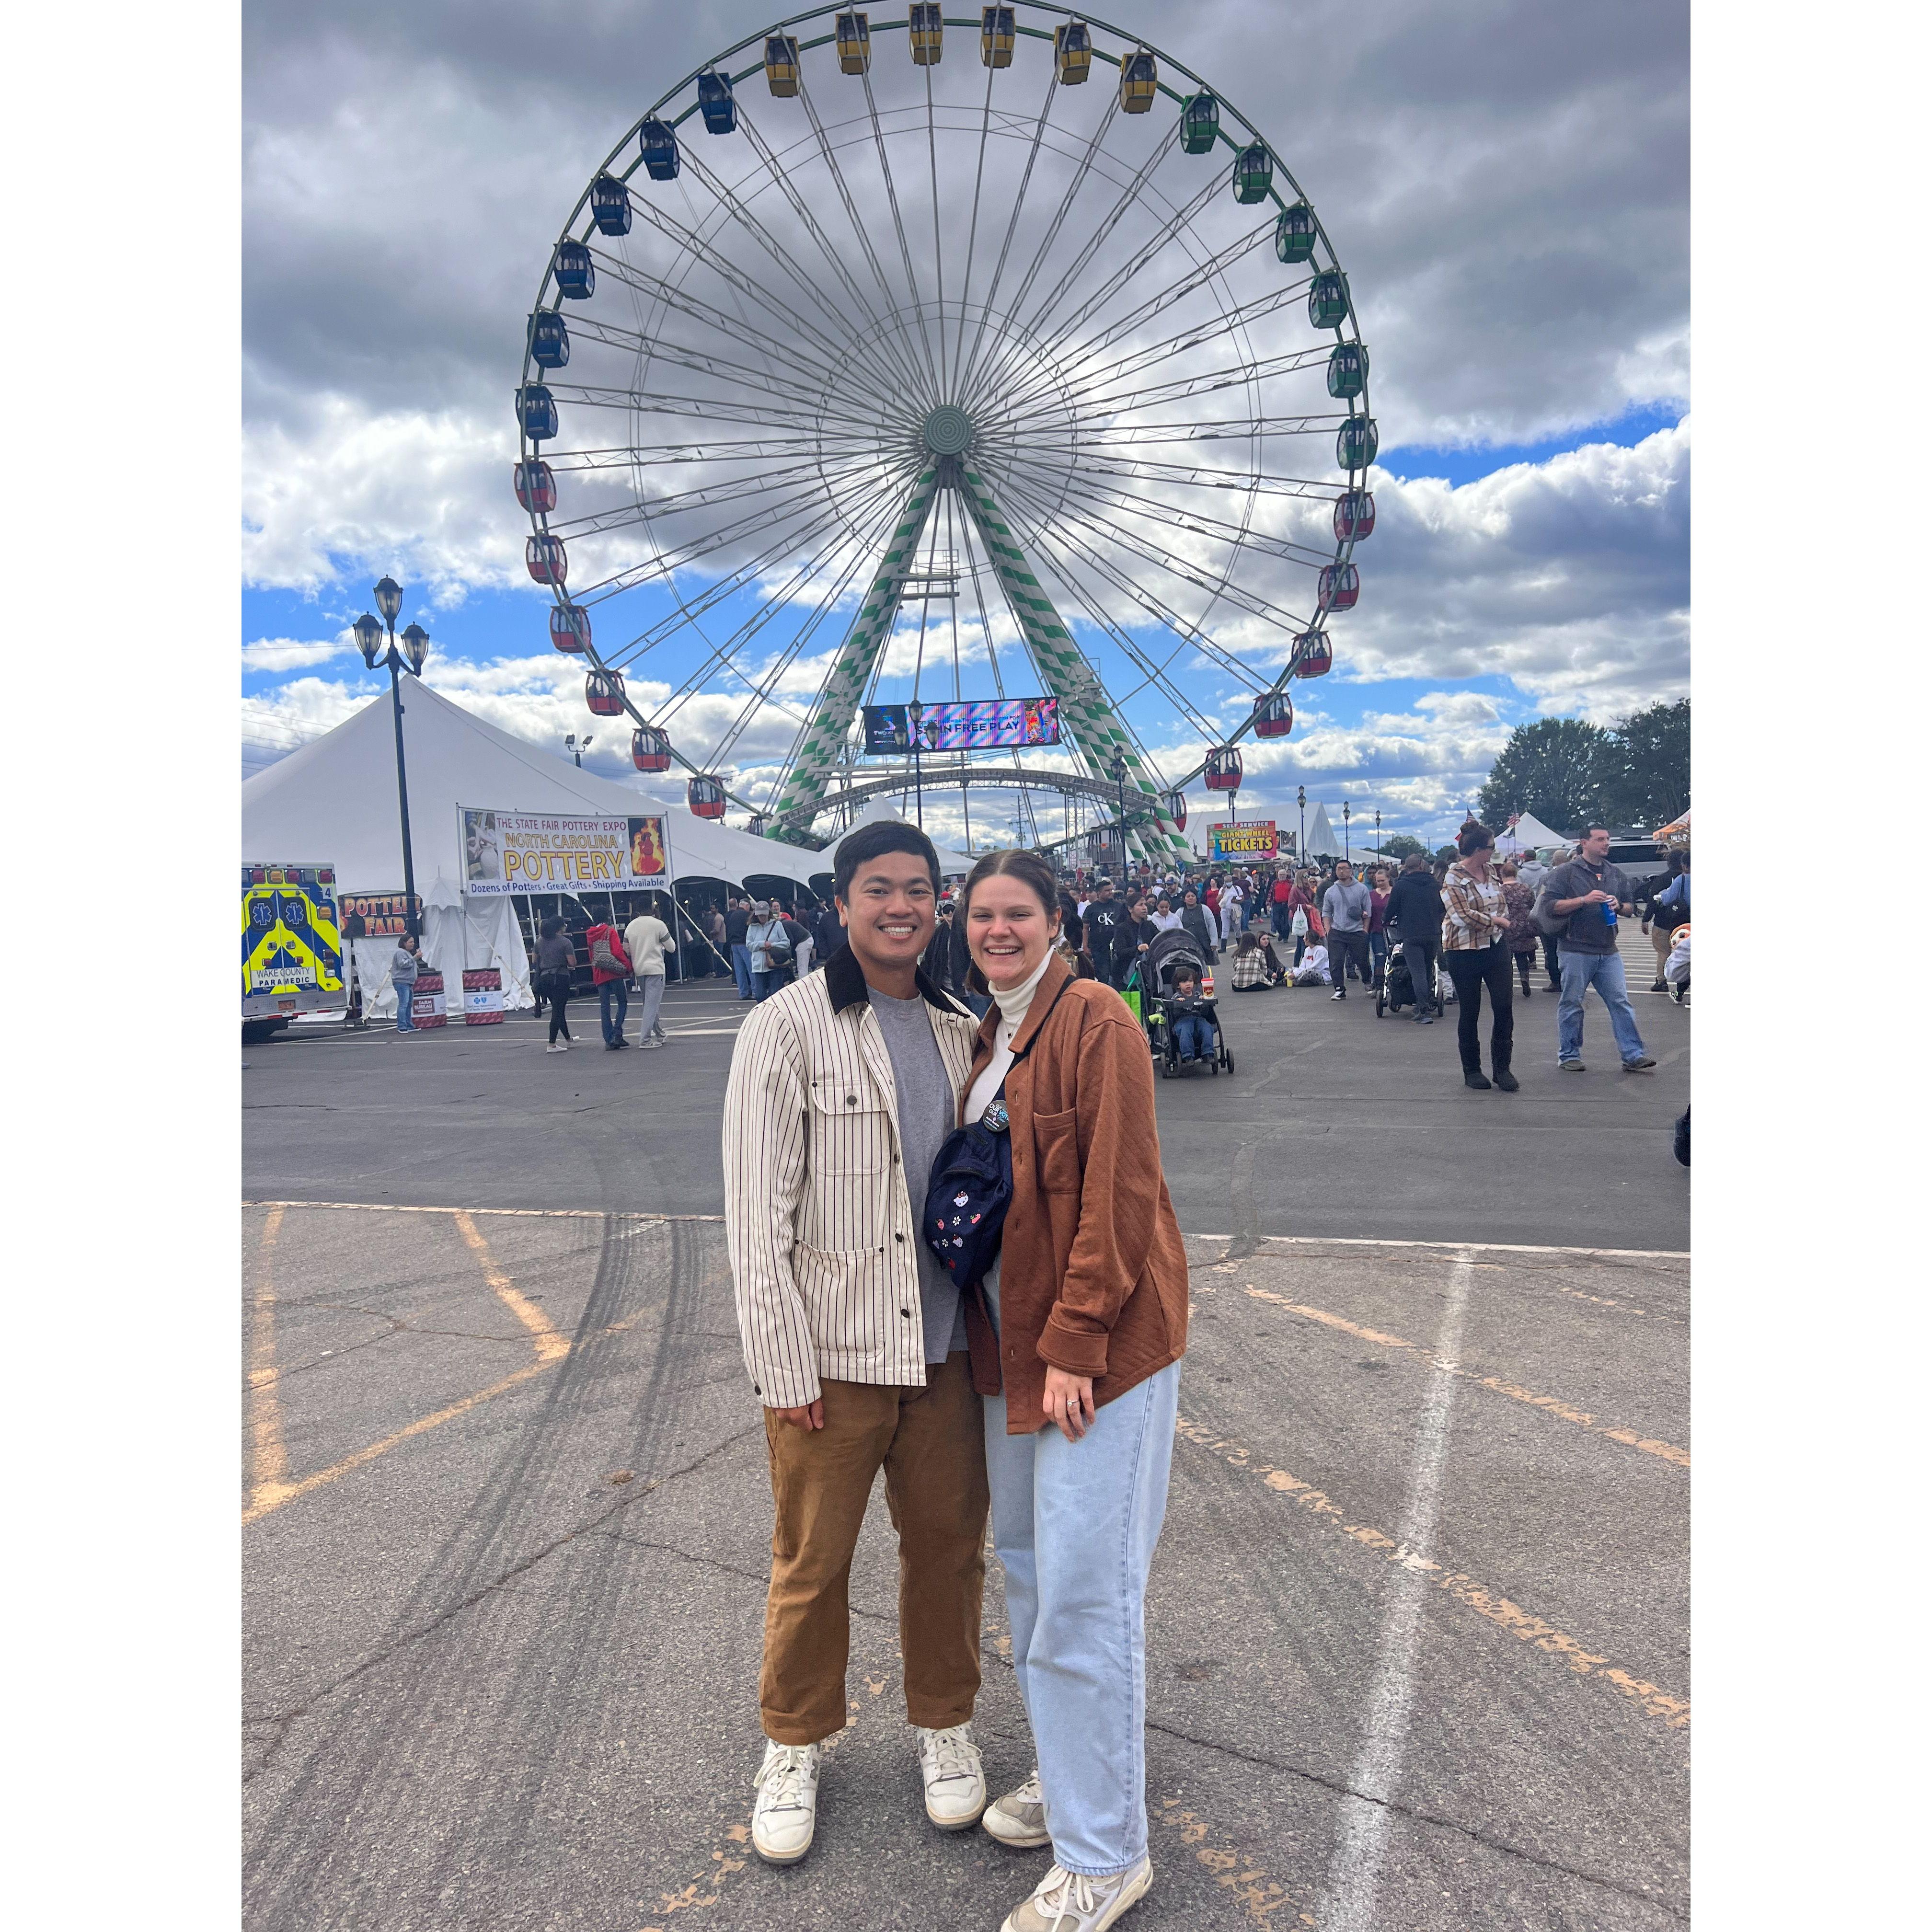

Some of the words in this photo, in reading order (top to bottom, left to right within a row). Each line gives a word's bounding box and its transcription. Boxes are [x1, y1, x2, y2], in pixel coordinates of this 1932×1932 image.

[955, 723, 987, 733] FREE
[989, 721, 1020, 731] PLAY
[496, 817, 513, 829] THE
[516, 819, 538, 830] STATE
[542, 820, 559, 830] FAIR
[563, 821, 598, 831] POTTERY
[603, 821, 626, 831] EXPO
[505, 833, 549, 849] NORTH
[552, 834, 618, 849] CAROLINA
[1219, 837, 1273, 852] TICKETS
[504, 850, 625, 881] POTTERY
[325, 887, 331, 897] 4
[471, 883, 500, 893] Dozens
[502, 882, 511, 892] of
[512, 883, 541, 891] Potters
[547, 881, 567, 890] Great
[569, 881, 587, 890] Gifts
[593, 880, 627, 891] Shipping
[628, 878, 665, 888] Available
[344, 895, 422, 917] POTTE
[363, 916, 407, 937] FAIR
[257, 969, 278, 978] WAKE
[280, 967, 310, 977] COUNTY
[259, 977, 310, 986] PARAMEDIC
[989, 1103, 1000, 1113] OUR
